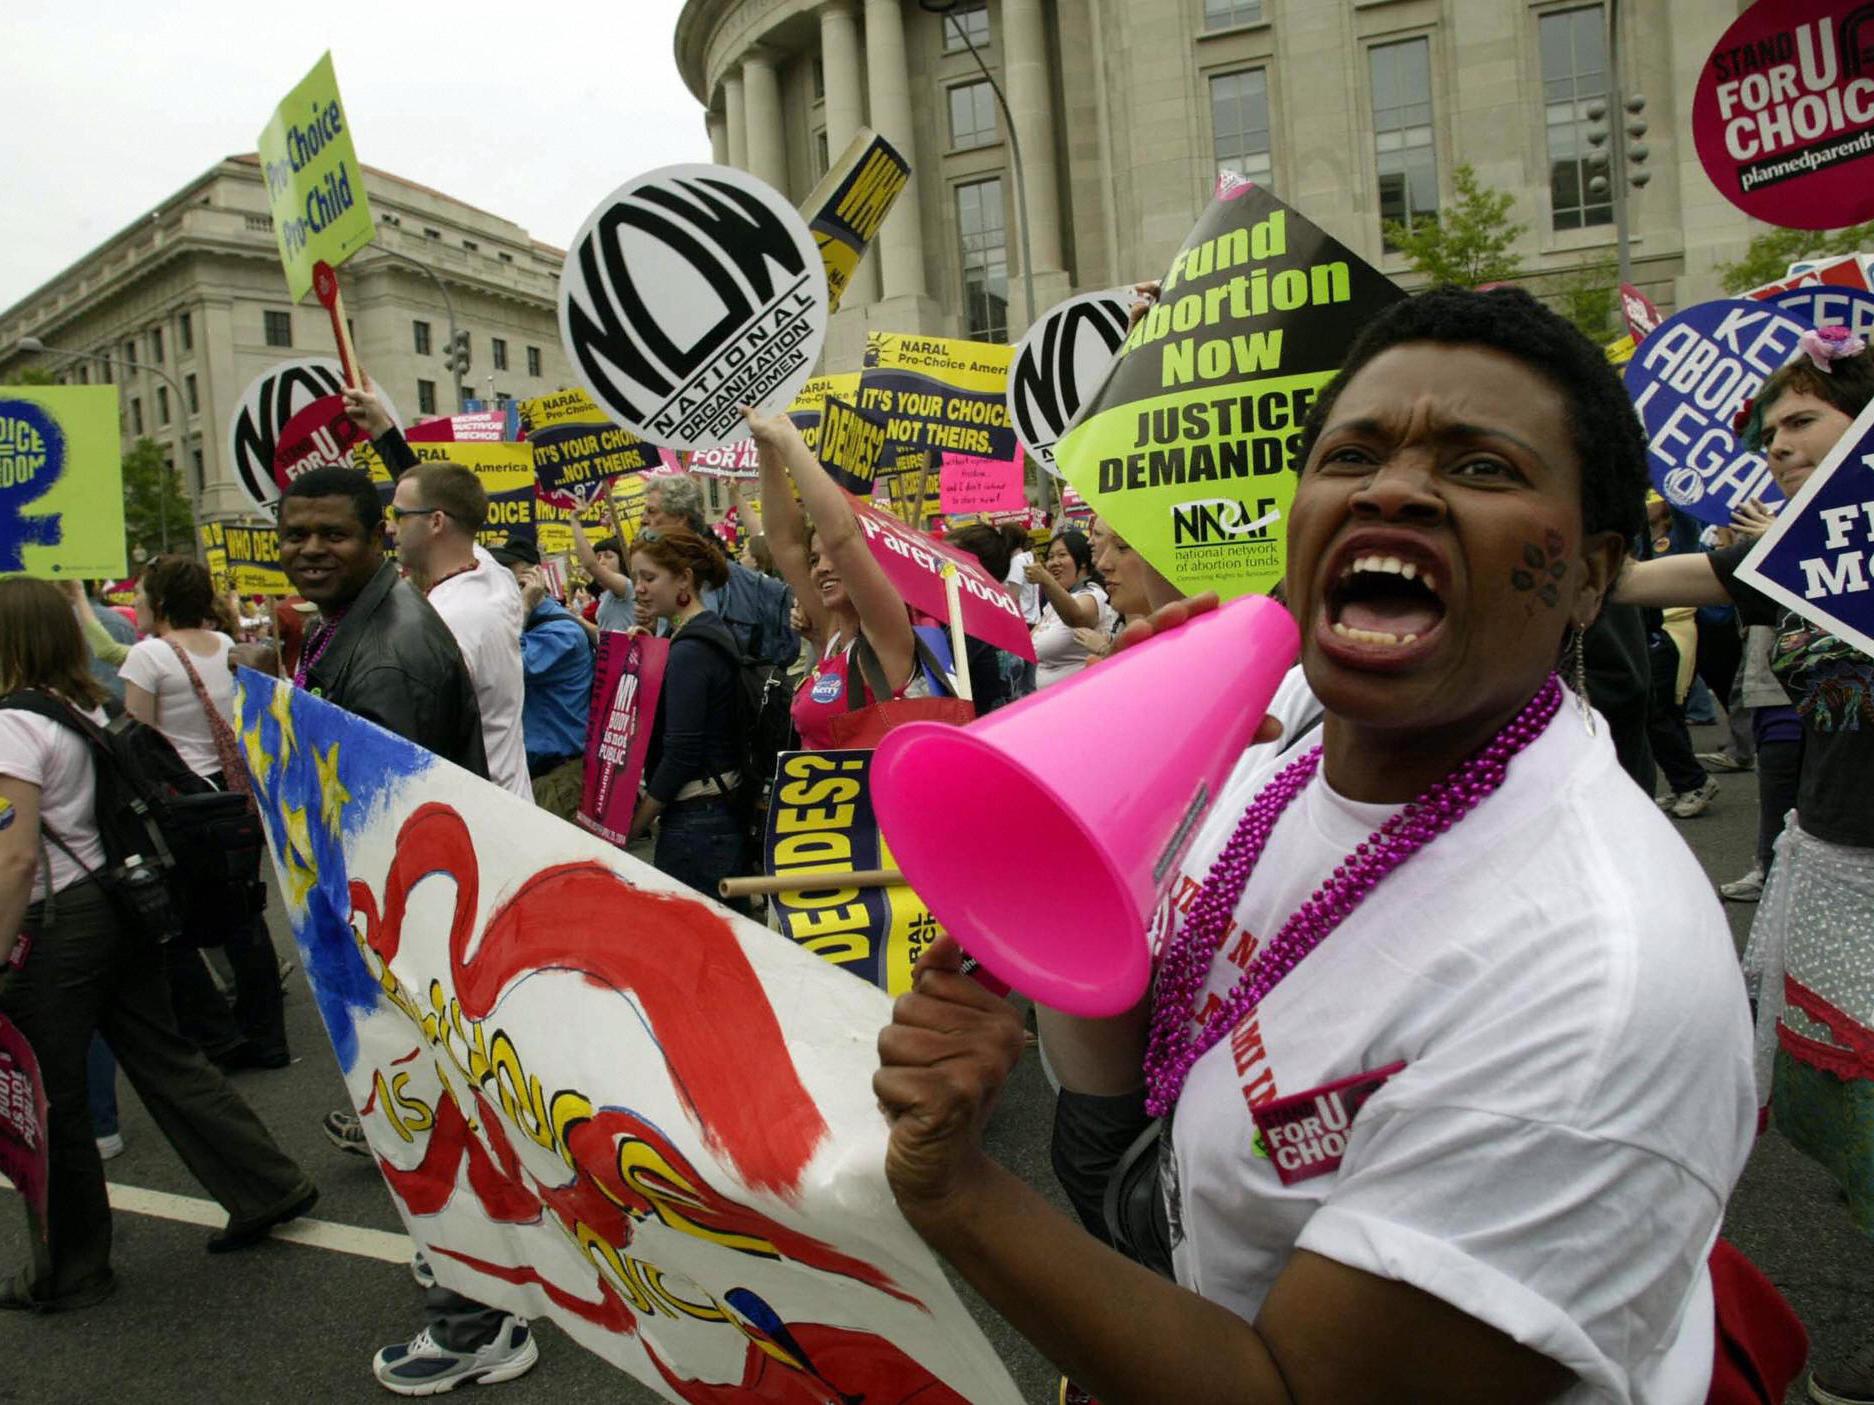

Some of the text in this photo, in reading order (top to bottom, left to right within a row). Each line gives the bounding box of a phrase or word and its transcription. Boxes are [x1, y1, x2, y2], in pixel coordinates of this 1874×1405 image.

[1714, 32, 1793, 80] STAND
[1716, 63, 1800, 121] FOR
[266, 99, 343, 203] Pro-Choice
[282, 160, 354, 264] Pro-Child
[1164, 209, 1287, 292] Fund
[568, 177, 806, 426] NOW
[653, 292, 813, 437] NATIONAL
[898, 353, 1009, 375] Pro-Choice Ameri
[900, 340, 950, 356] NARAL
[1161, 329, 1284, 388] Now
[679, 317, 812, 442] ORGANIZATION
[709, 348, 805, 437] FOR WOMEN
[542, 393, 583, 411] NARAL
[861, 388, 894, 412] IT'S
[897, 391, 944, 418] YOUR
[534, 445, 560, 466] IT'S
[560, 434, 600, 460] YOUR
[886, 418, 993, 454] NOT THEIRS.
[416, 448, 450, 461] RAL
[474, 462, 528, 473] America
[593, 450, 646, 475] THEIRS.
[693, 447, 737, 468] FOR
[487, 501, 531, 524] OICE
[858, 513, 1021, 618] Parenhood
[1175, 543, 1278, 560] national network
[1176, 554, 1280, 573] of abortion funds
[614, 673, 638, 711] MY
[598, 742, 627, 766] PUBLIC
[908, 912, 924, 964] RAL
[1267, 1115, 1322, 1150] FOR
